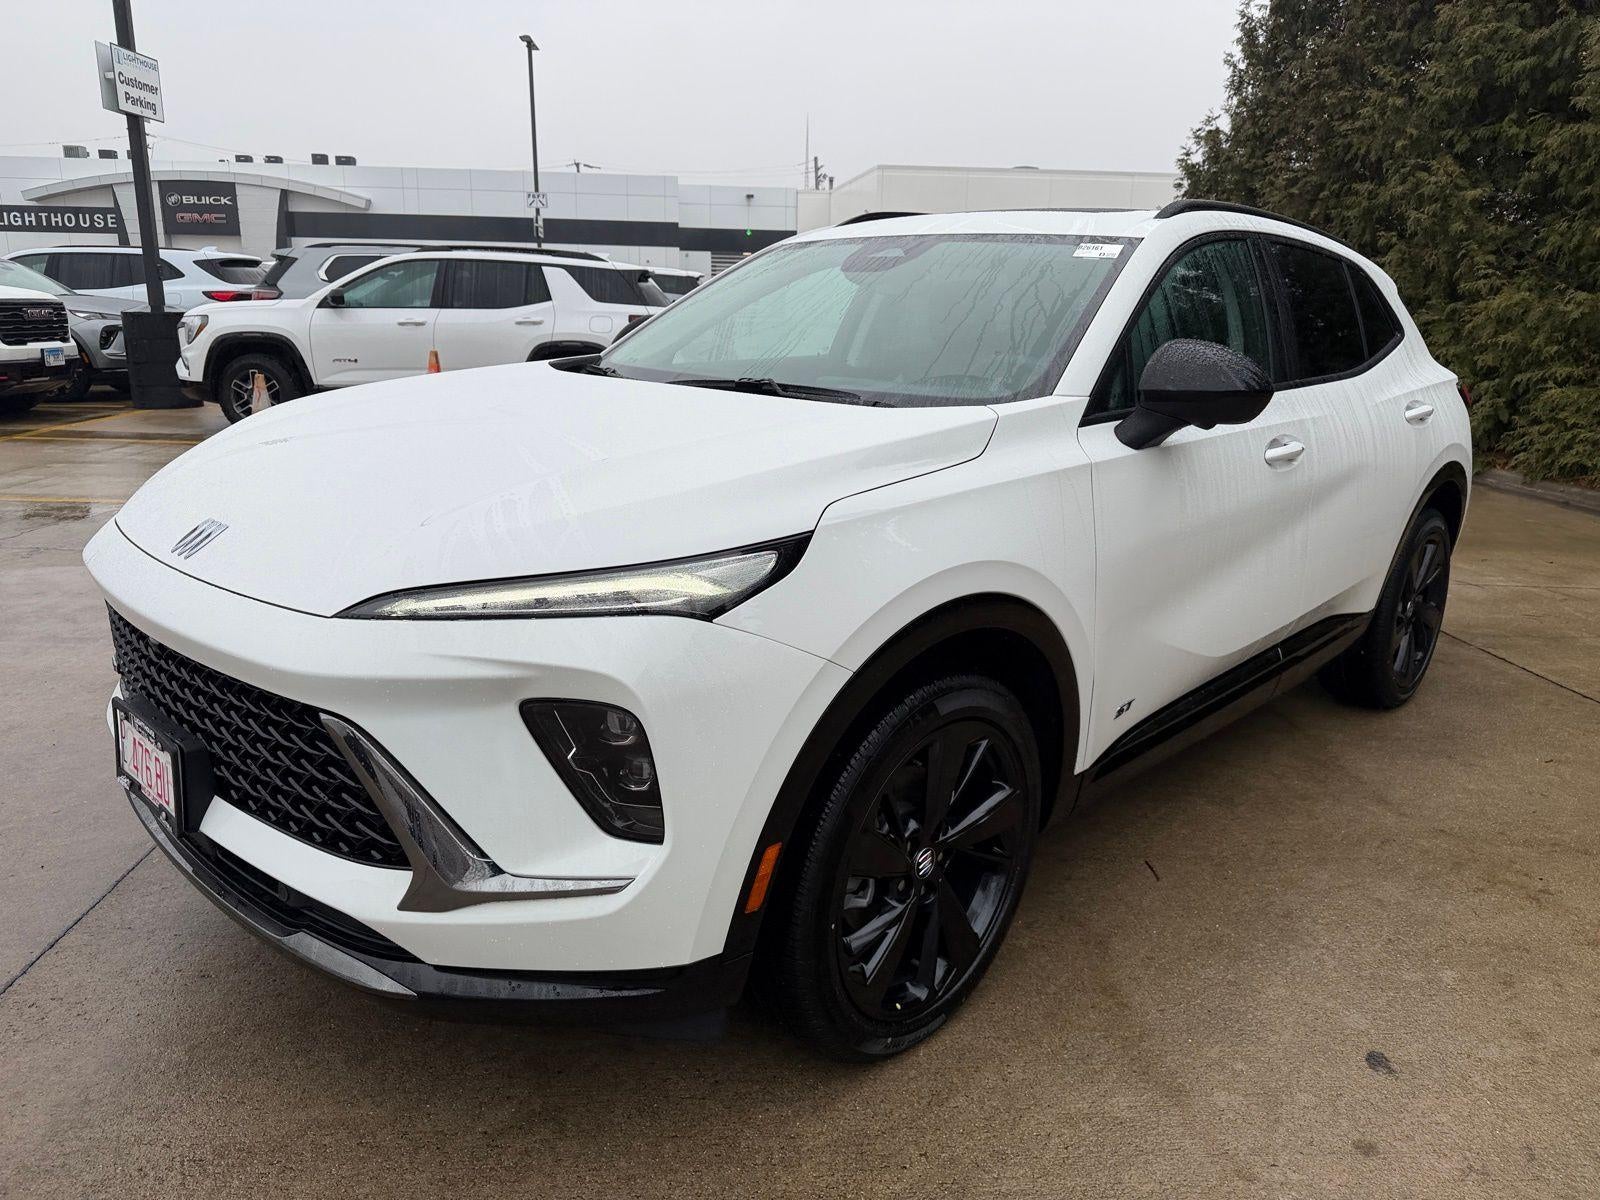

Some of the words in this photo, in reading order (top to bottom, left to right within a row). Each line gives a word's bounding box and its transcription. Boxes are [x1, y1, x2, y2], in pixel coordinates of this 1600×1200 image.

[122, 52, 158, 72] LIGHTHOUSE
[117, 70, 159, 96] Customer
[124, 90, 157, 115] Parking
[182, 195, 233, 205] BUICK
[176, 212, 227, 224] GMC
[132, 736, 153, 790] 476
